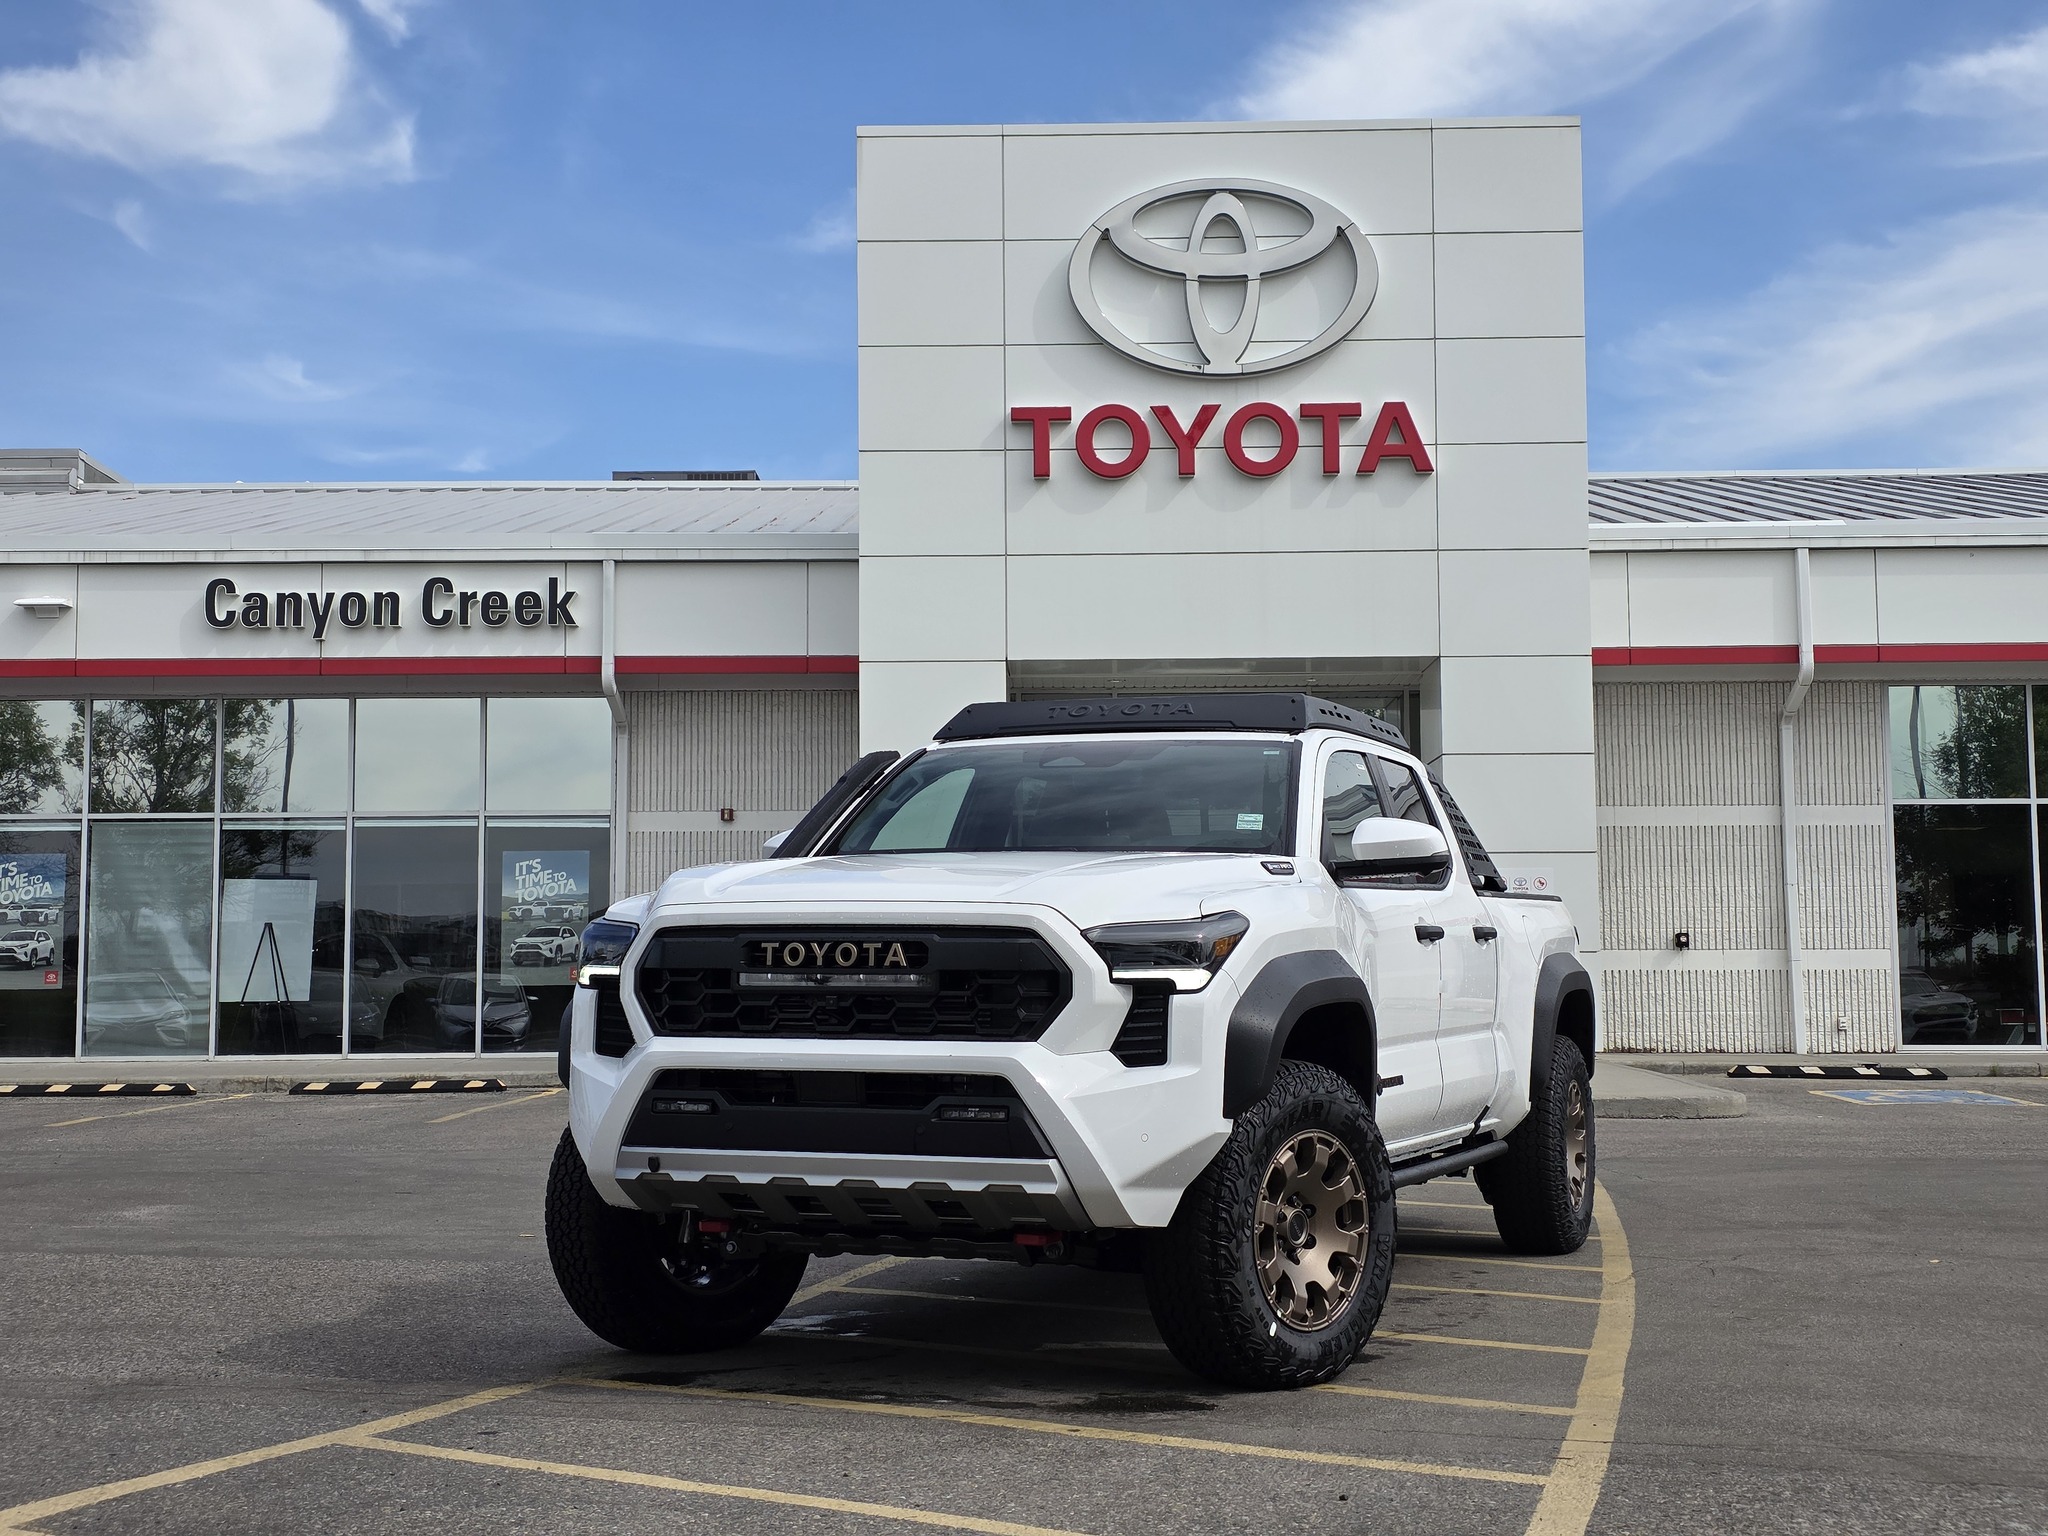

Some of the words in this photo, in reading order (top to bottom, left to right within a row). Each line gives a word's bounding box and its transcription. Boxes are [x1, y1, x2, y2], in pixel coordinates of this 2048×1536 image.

[1010, 401, 1435, 480] TOYOTA
[204, 578, 402, 641] Canyon
[420, 577, 579, 628] Creek
[1048, 702, 1194, 718] TOYOTA
[0, 862, 18, 878] T'S
[515, 859, 541, 876] IT'S
[0, 873, 28, 892] IME
[29, 875, 42, 886] TO
[515, 870, 552, 889] TIME
[553, 872, 567, 882] TO
[515, 879, 577, 903] TOYOTA
[0, 882, 52, 904] OYOTA
[761, 942, 907, 967] TOYOTA
[1319, 1233, 1390, 1356] WRANGLER
[1255, 1306, 1297, 1355] TERRORY
